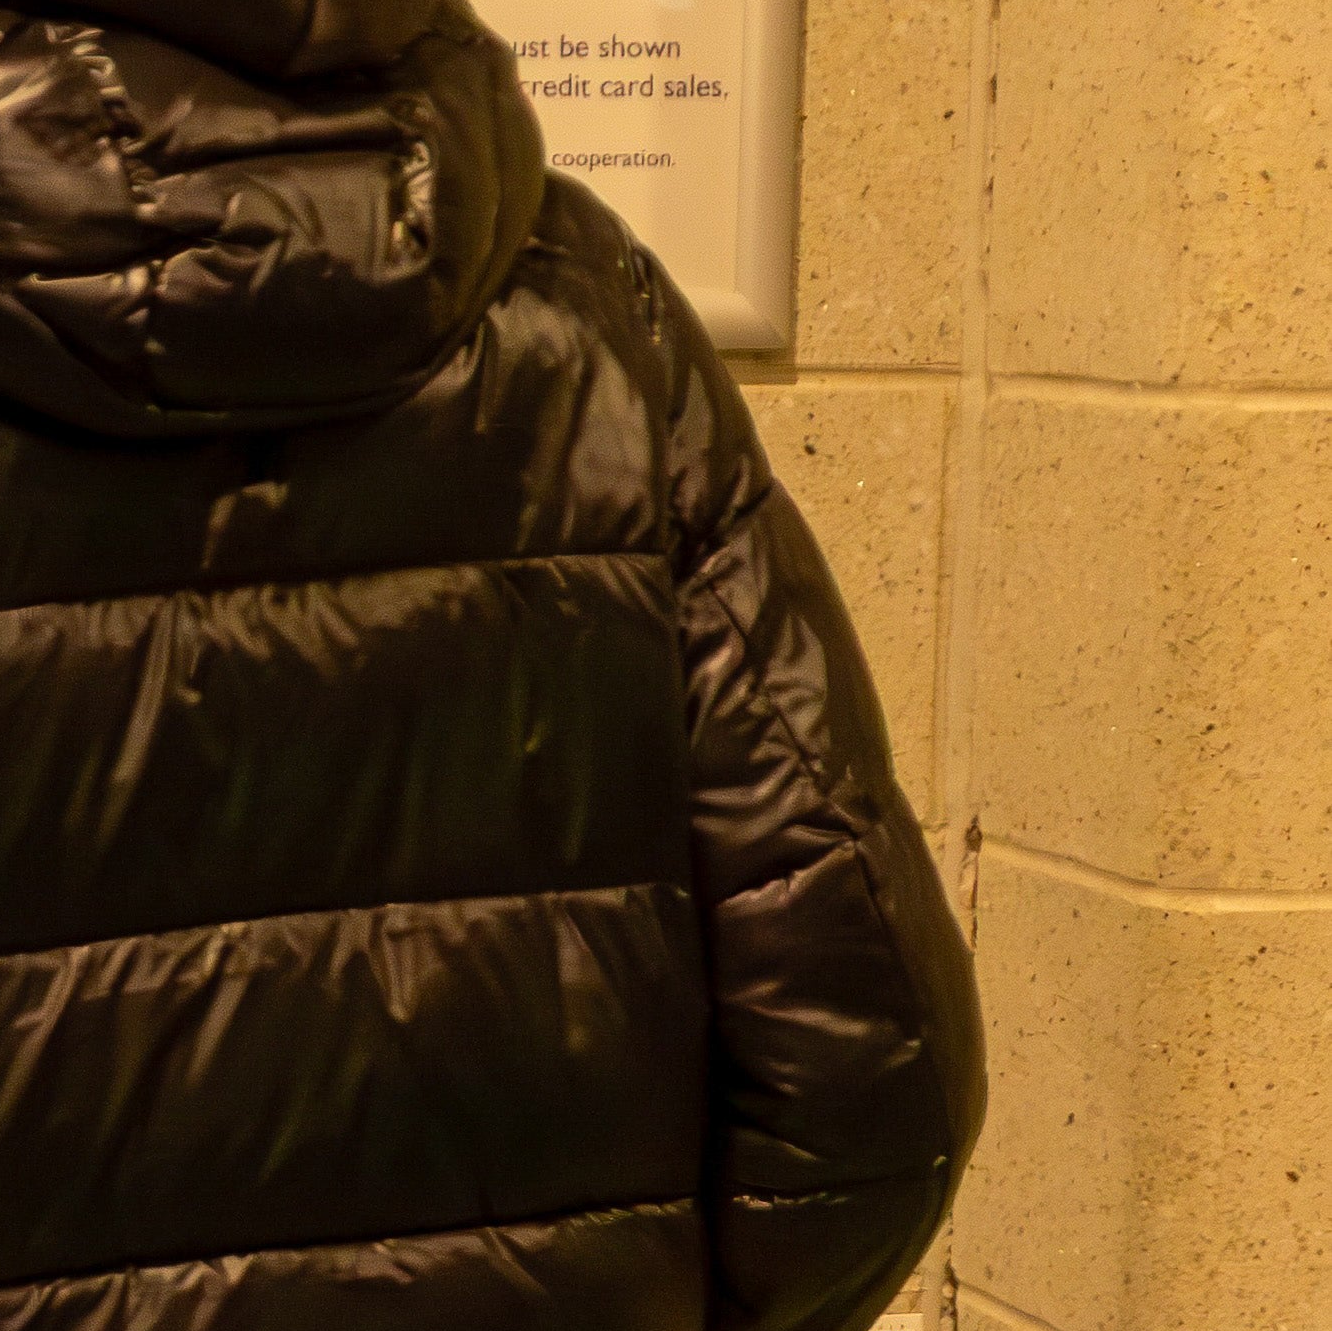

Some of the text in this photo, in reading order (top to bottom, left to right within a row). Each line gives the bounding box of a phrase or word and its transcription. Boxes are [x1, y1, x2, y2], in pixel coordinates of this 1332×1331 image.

[512, 33, 681, 58] ust be shown
[600, 73, 654, 98] card
[551, 149, 676, 173] cooperation.
